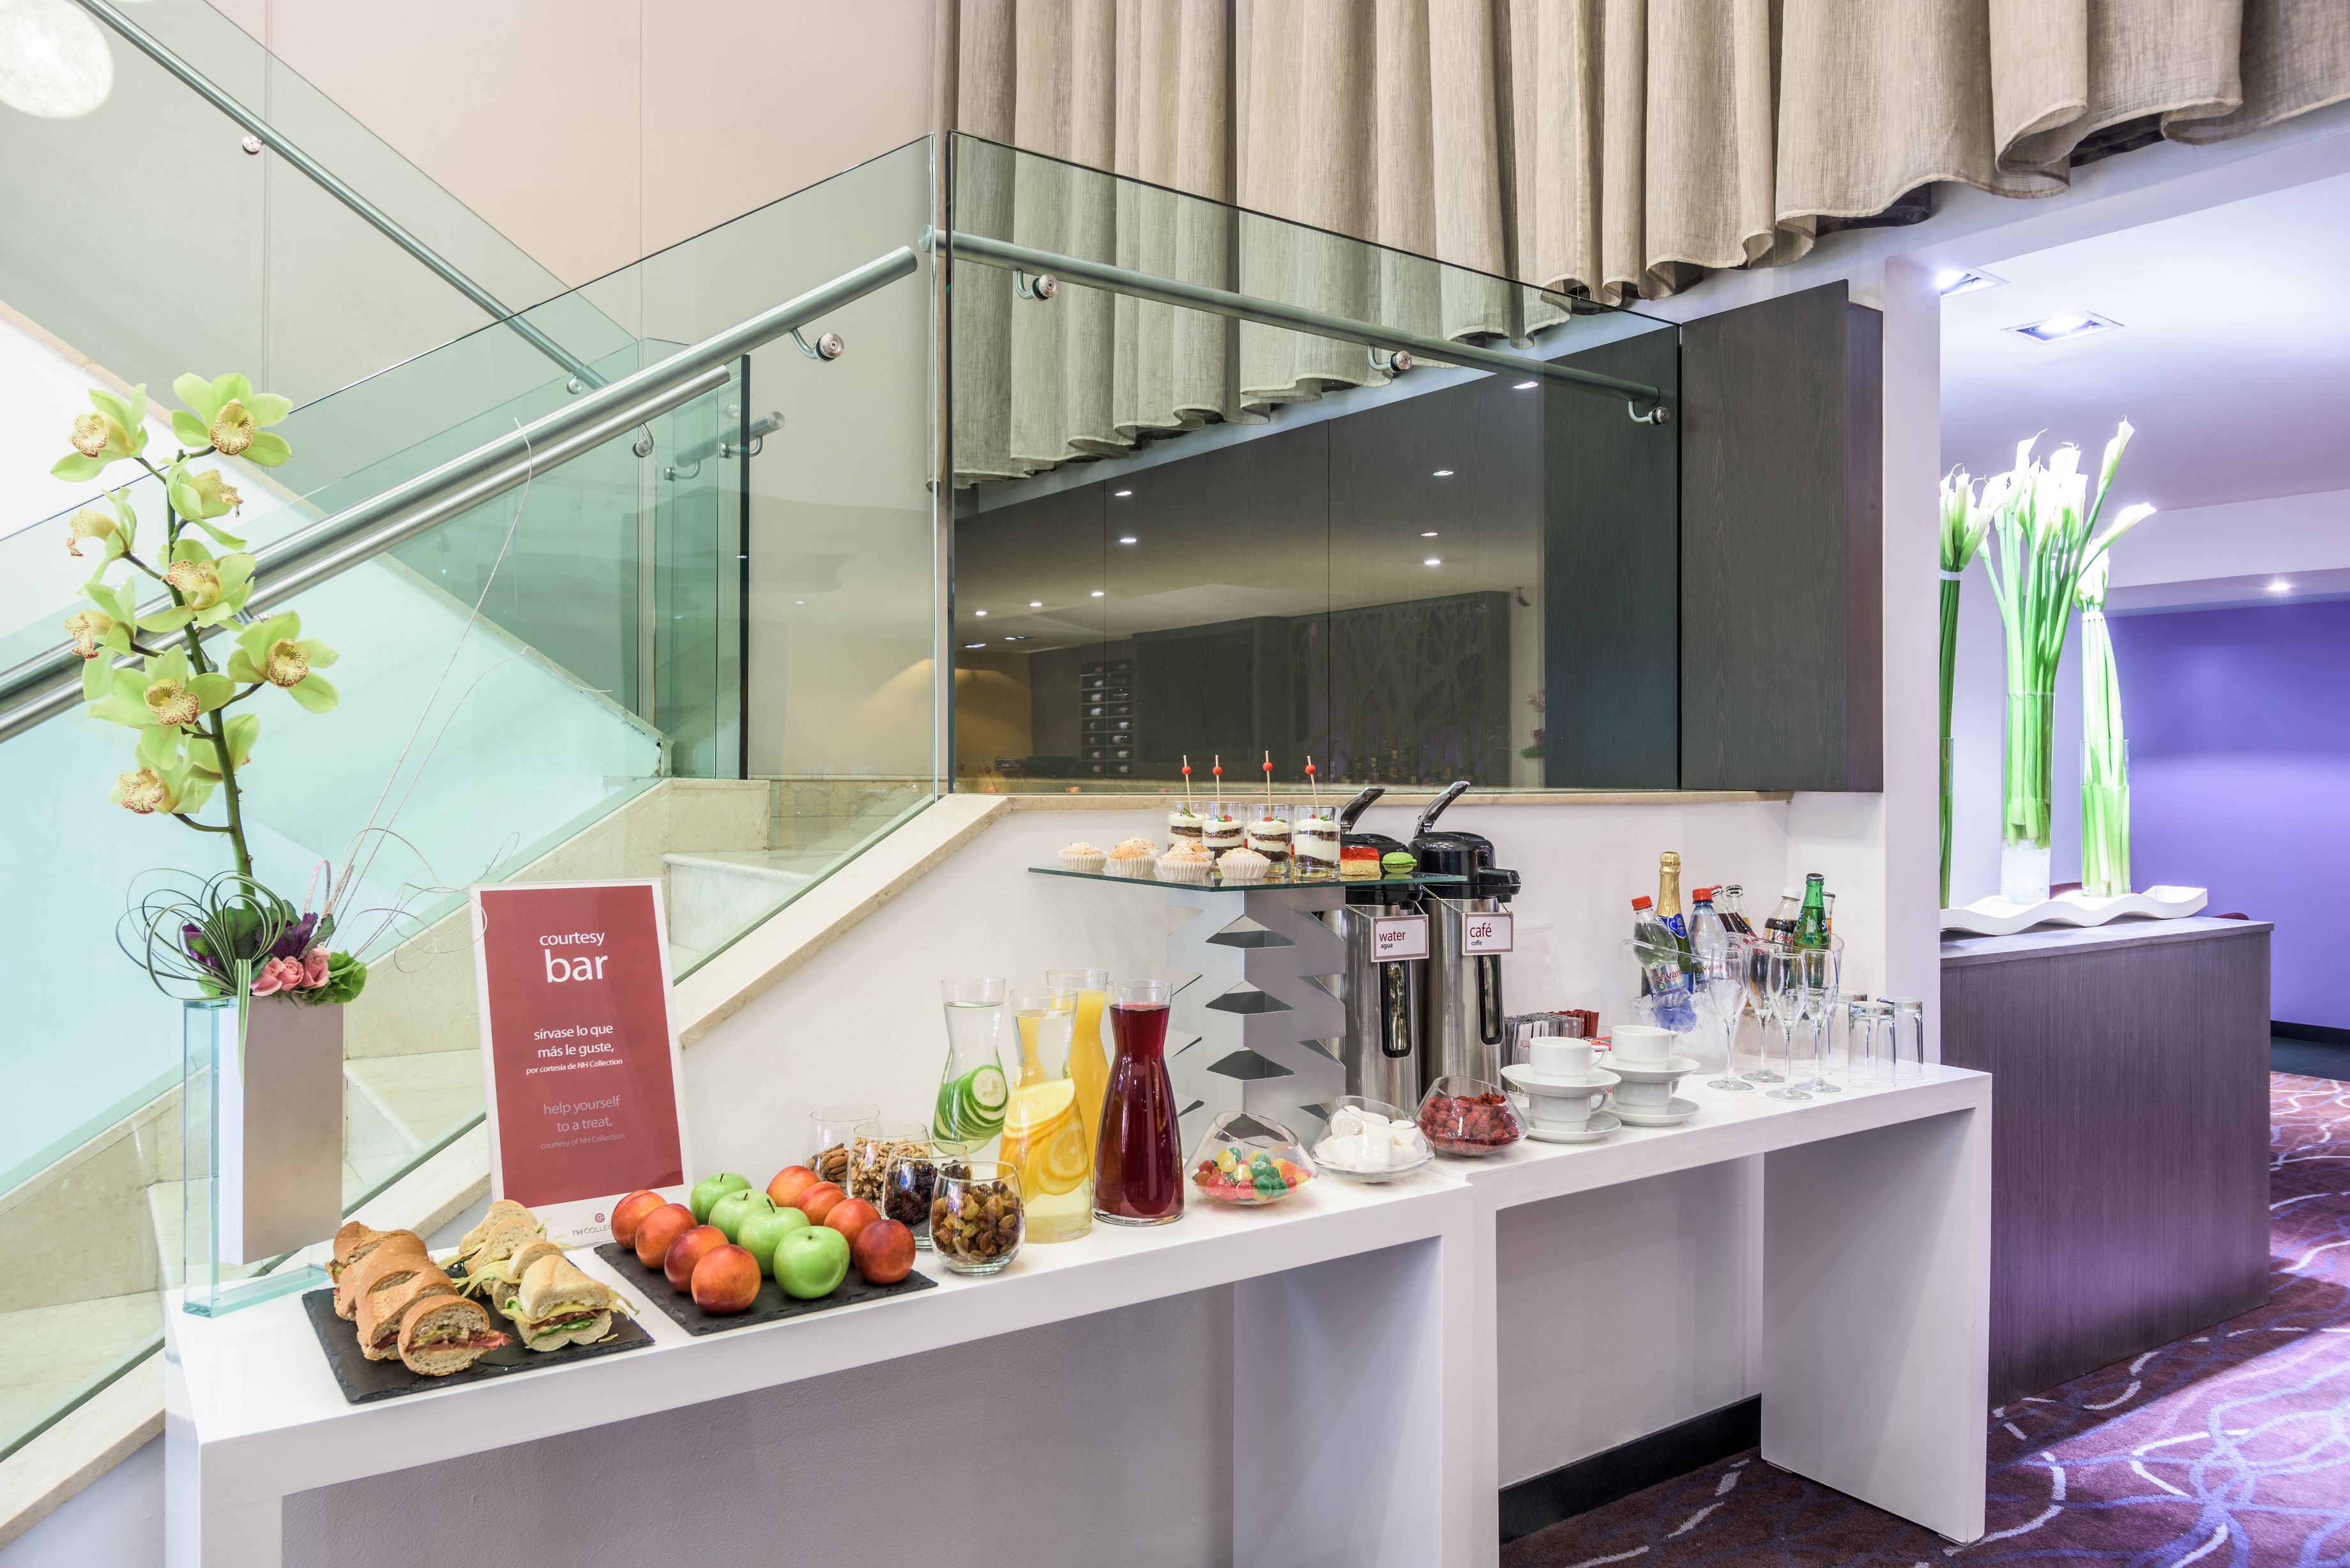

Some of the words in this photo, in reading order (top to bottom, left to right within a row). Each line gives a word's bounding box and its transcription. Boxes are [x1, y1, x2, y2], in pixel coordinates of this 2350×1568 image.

[1379, 931, 1406, 942] water
[1469, 923, 1492, 937] café
[539, 932, 605, 946] courtesy
[544, 949, 608, 983] bar
[534, 1028, 574, 1040] sírvase
[577, 1025, 588, 1036] lo
[590, 1025, 613, 1037] que
[538, 1045, 563, 1058] más
[565, 1044, 576, 1055] le
[579, 1042, 614, 1057] guste,
[526, 1067, 539, 1075] por
[540, 1064, 566, 1073] cortesía
[589, 1059, 623, 1067] Collection
[543, 1102, 571, 1115] help
[573, 1095, 620, 1114] yourself
[556, 1122, 569, 1132] to
[572, 1122, 579, 1130] a
[582, 1117, 612, 1129] treat,
[541, 1140, 570, 1149] courtesy
[591, 1133, 625, 1142] Collection
